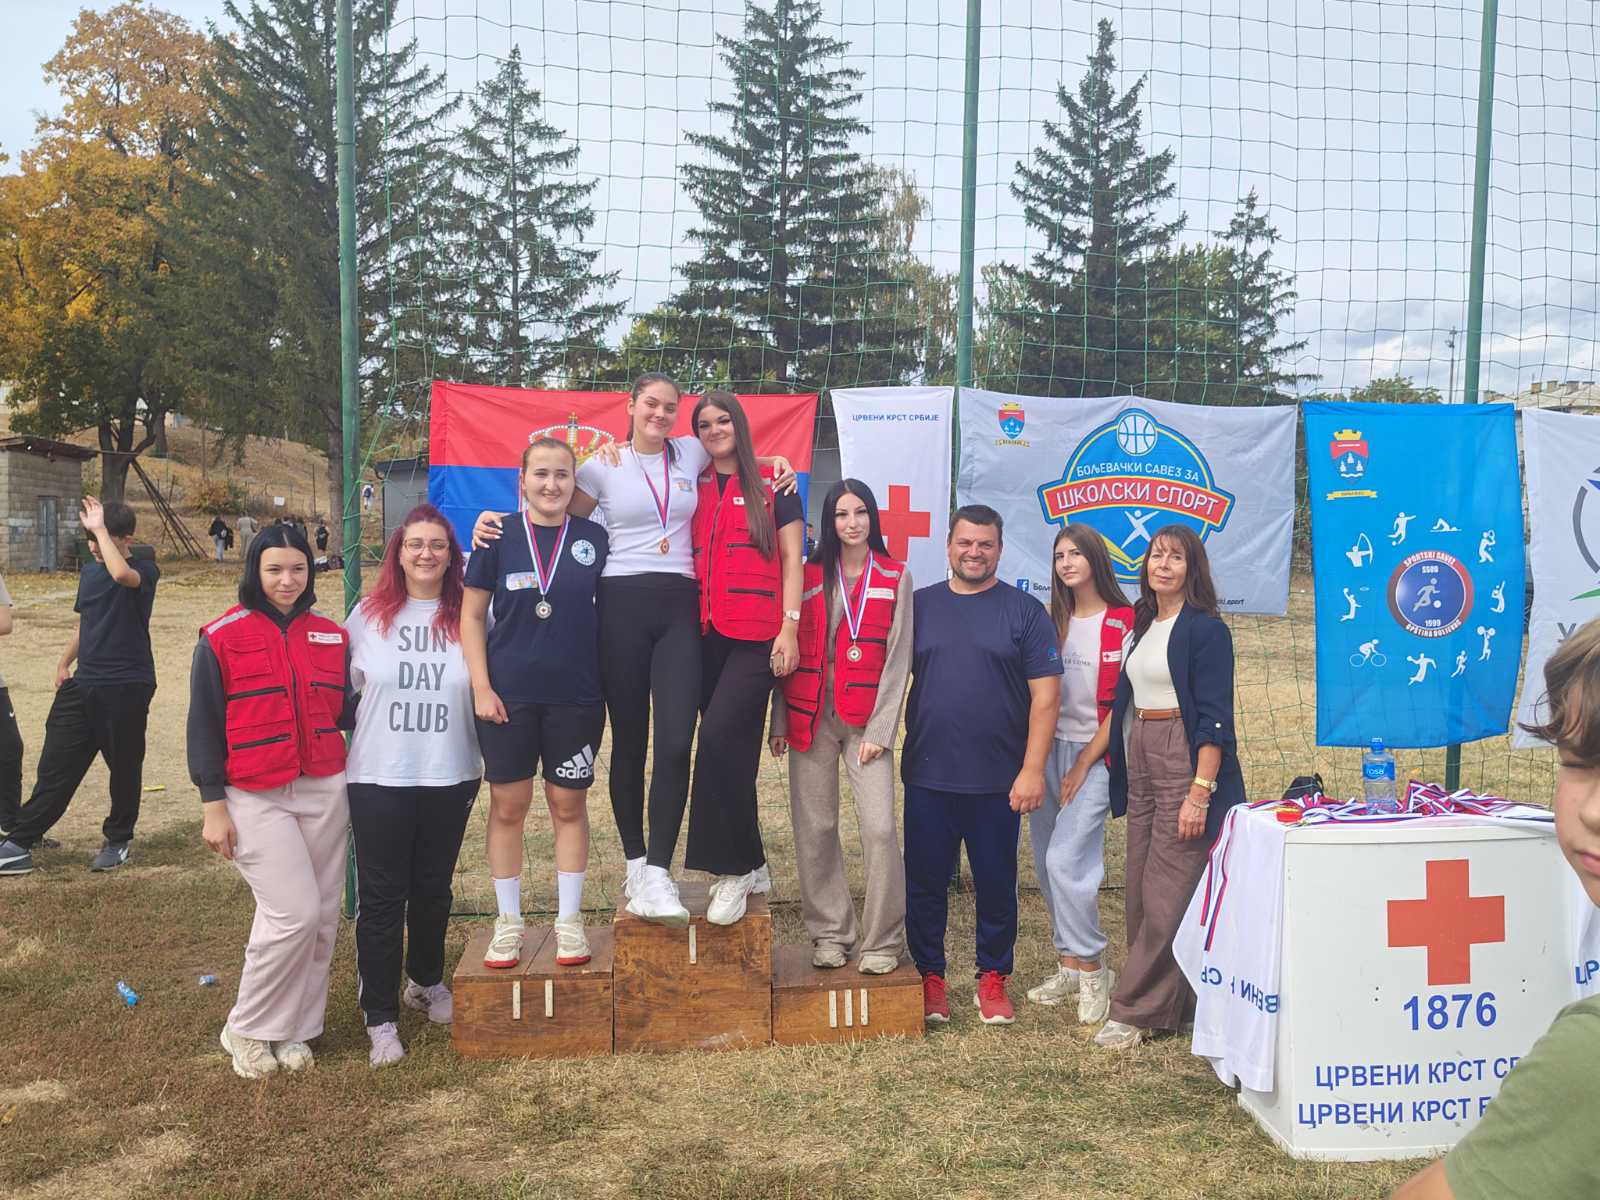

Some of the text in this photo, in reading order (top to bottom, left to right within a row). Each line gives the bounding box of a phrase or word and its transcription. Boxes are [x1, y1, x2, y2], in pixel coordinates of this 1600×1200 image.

[852, 413, 940, 422] ЦРВЕНИ КРСТ СРБИЈЕ
[1076, 462, 1200, 482] БОЉЕВАЧКИ САВЕЗ ЗА
[1056, 481, 1219, 516] ШКОЛСКИ СПОРТ
[397, 625, 447, 653] SUN
[398, 661, 447, 691] DAY
[388, 701, 449, 733] CLUB
[1403, 991, 1497, 1031] 1876
[1315, 1063, 1420, 1091] ЦРВЕНИ
[1428, 1059, 1487, 1084] КРСТ
[1298, 1101, 1404, 1129] ЦРВЕНИ
[1411, 1097, 1472, 1123] КРСТ
